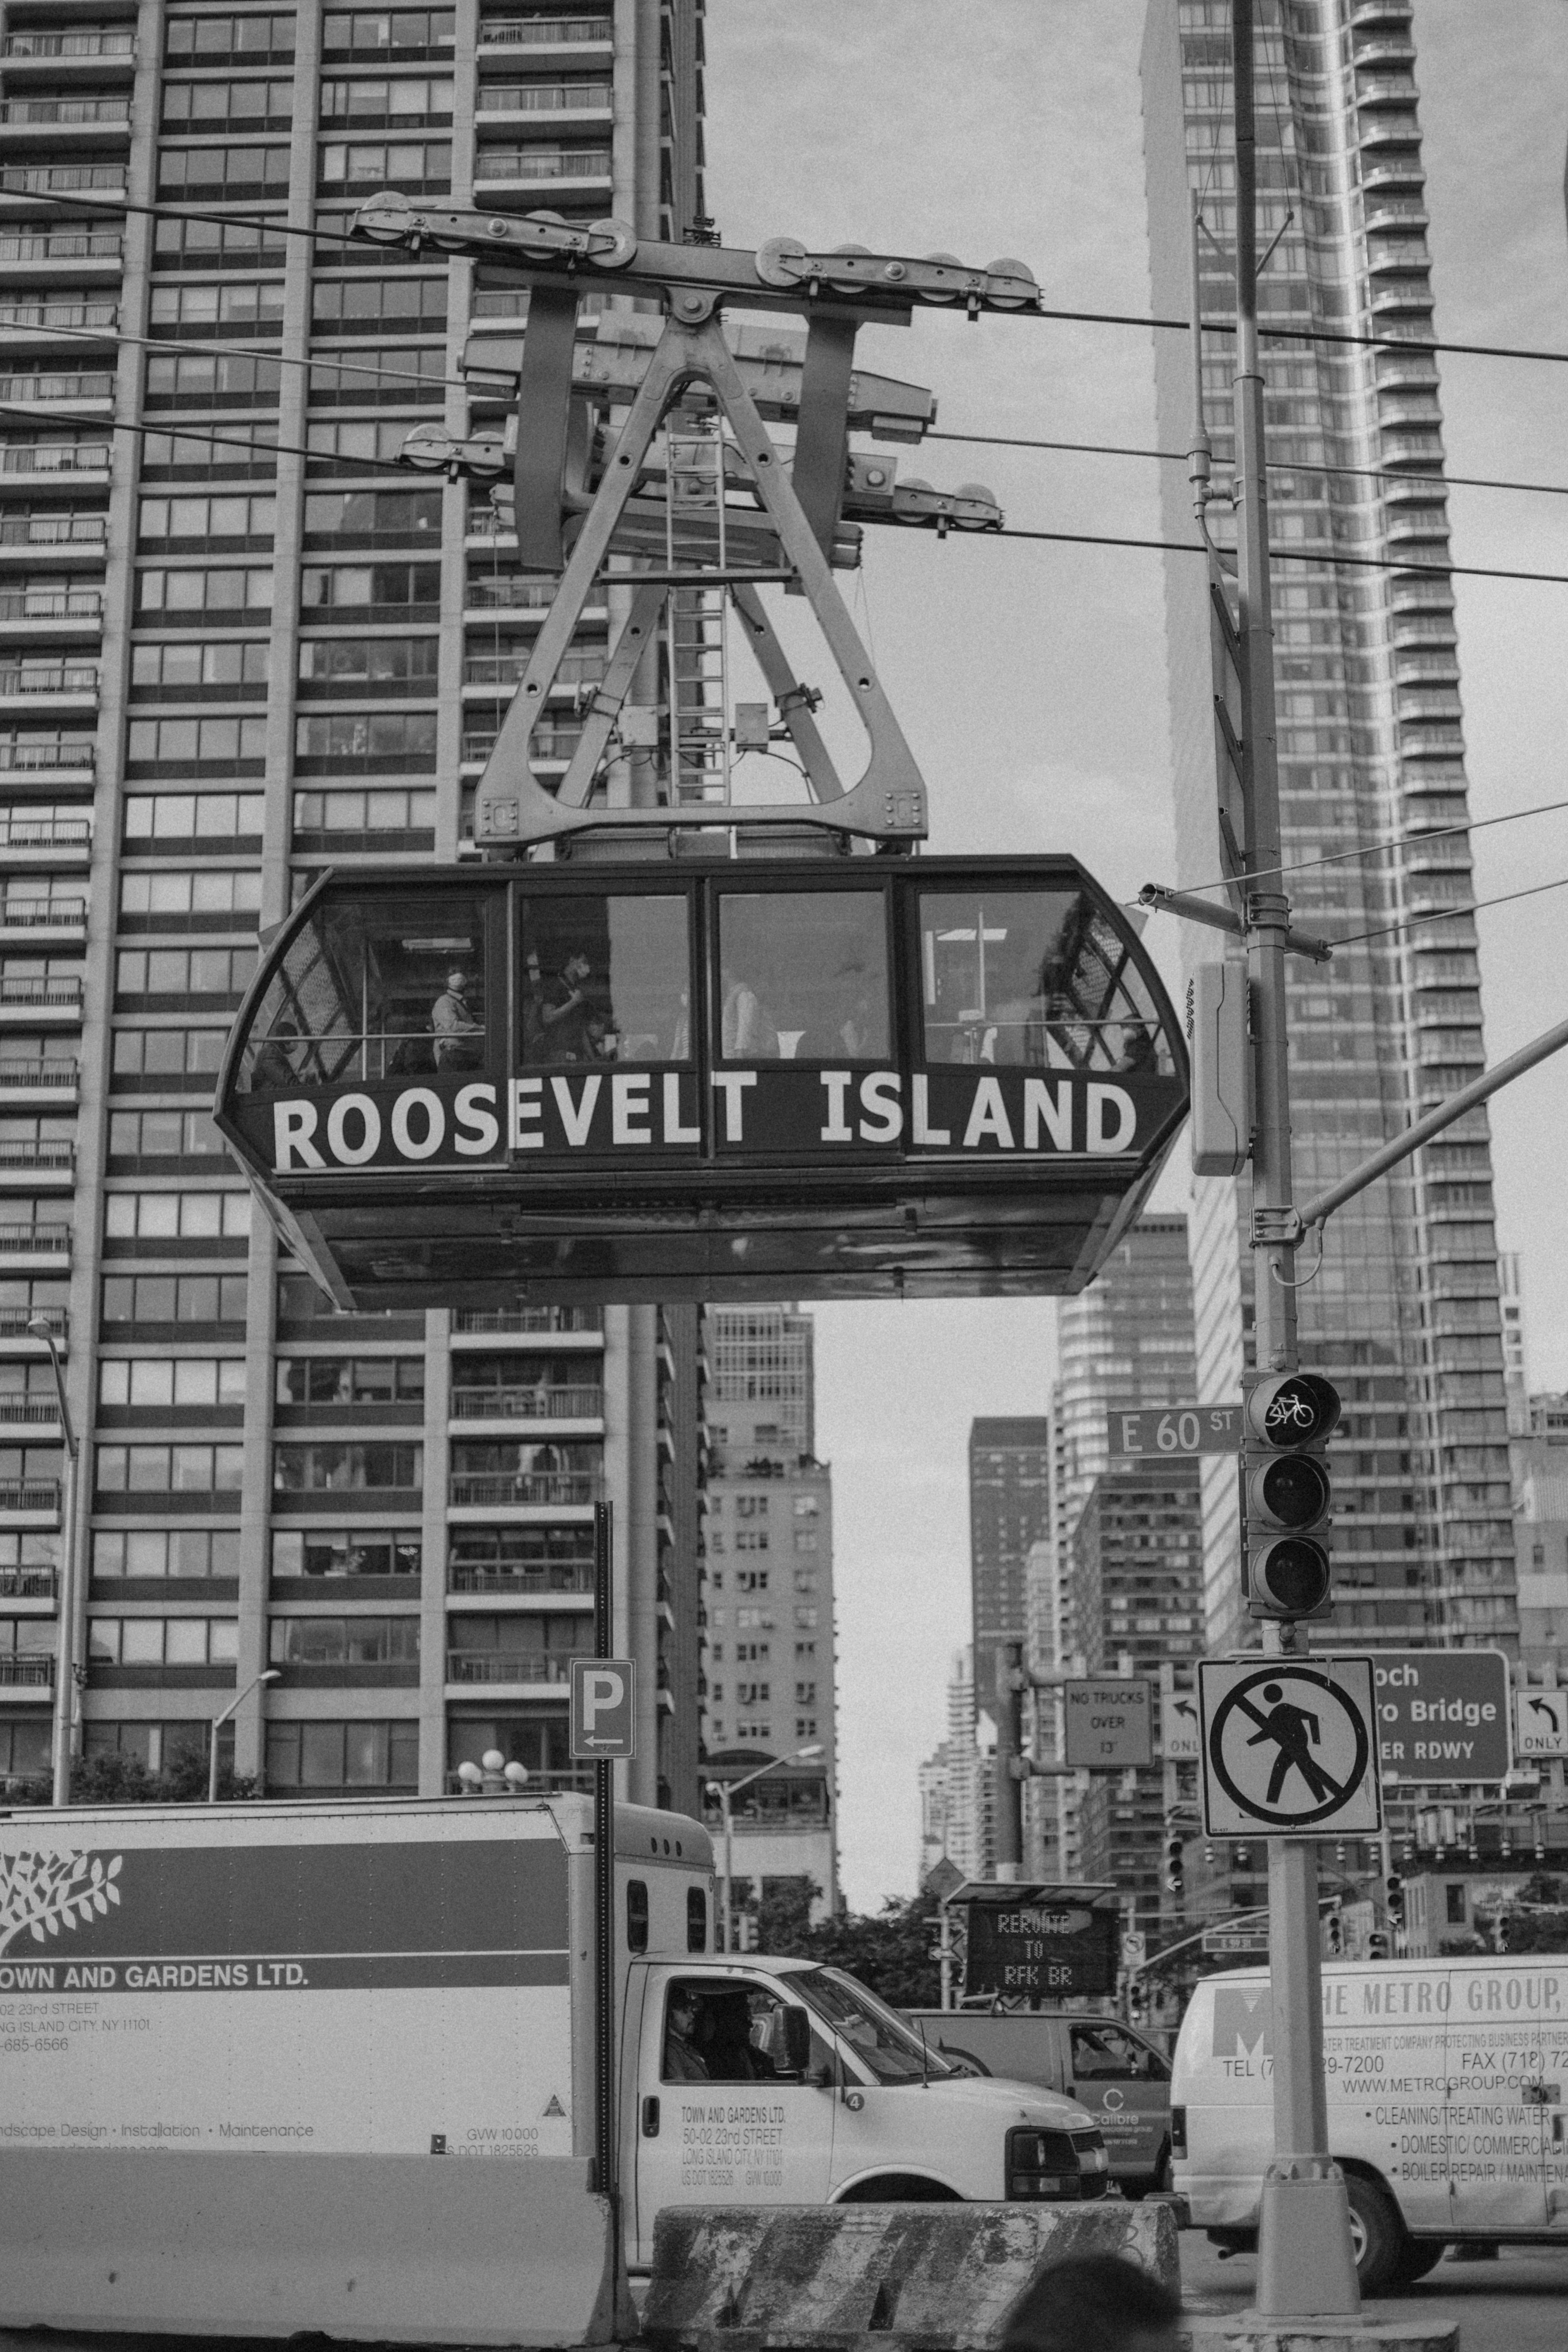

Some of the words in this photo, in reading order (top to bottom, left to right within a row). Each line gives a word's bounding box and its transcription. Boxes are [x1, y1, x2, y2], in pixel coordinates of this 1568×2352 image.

[273, 1071, 757, 1170] ROOSEVELT
[820, 1071, 1136, 1153] ISLAND
[1122, 1415, 1142, 1452] E
[1157, 1412, 1200, 1451] 60
[1210, 1411, 1234, 1431] ST
[1376, 1663, 1418, 1686] och
[583, 1671, 624, 1730] P
[1071, 1693, 1089, 1705] NO
[1094, 1692, 1145, 1704] TRUCKS
[1410, 1697, 1497, 1727] Bridge
[1090, 1717, 1125, 1729] OVER
[1381, 1742, 1405, 1759] ER
[1414, 1741, 1474, 1759] RDWY
[1525, 1737, 1562, 1749] ONLY
[998, 1914, 1070, 1934] REROUTE
[1024, 1940, 1043, 1959] TO
[64, 1967, 116, 1988] AND
[125, 1964, 248, 1988] GARDENS
[257, 1963, 308, 1986] LTD.
[1005, 1966, 1038, 1985] RFK
[1048, 1966, 1072, 1985] BR
[1364, 1981, 1452, 2014] METRO
[1468, 1978, 1560, 2013] GROUP,
[18, 2003, 47, 2015] 23rd
[52, 2003, 99, 2015] STREET
[20, 2021, 64, 2033] ISLAND
[102, 2020, 118, 2031] NY
[123, 2019, 150, 2030] 11101
[1345, 2037, 1392, 2051] TREATMENT
[1394, 2035, 1433, 2050] COMPANY
[1435, 2034, 1486, 2049] PROTECTING
[1489, 2033, 1528, 2047] BUSINESS
[1223, 2060, 1255, 2076] TEL
[1462, 2052, 1495, 2070] FAX
[1503, 2051, 1545, 2074] (718)
[849, 2096, 860, 2108] 4
[682, 2107, 705, 2123] TOWN
[708, 2107, 725, 2123] AND
[728, 2107, 767, 2123] GARDENS
[769, 2107, 786, 2123] LTD.
[1507, 2107, 1550, 2125] WATER
[61, 2122, 107, 2141] Design
[121, 2122, 200, 2137] Installation
[219, 2123, 314, 2137] Maintenance
[467, 2128, 497, 2141] GVW
[683, 2128, 712, 2144] 50-02
[715, 2128, 740, 2145] 23rd
[743, 2128, 783, 2145] STREET
[459, 2145, 485, 2156] DOT
[490, 2144, 538, 2156] 1825526
[1474, 2136, 1558, 2155] COMMERCIAL
[683, 2149, 704, 2165] LONG
[706, 2149, 732, 2165] ISLAND
[754, 2149, 765, 2165] NY
[682, 2170, 691, 2185] US
[693, 2170, 706, 2185] DOT
[1403, 2162, 1448, 2181] BOILER
[1452, 2163, 1496, 2181] REPAIR
